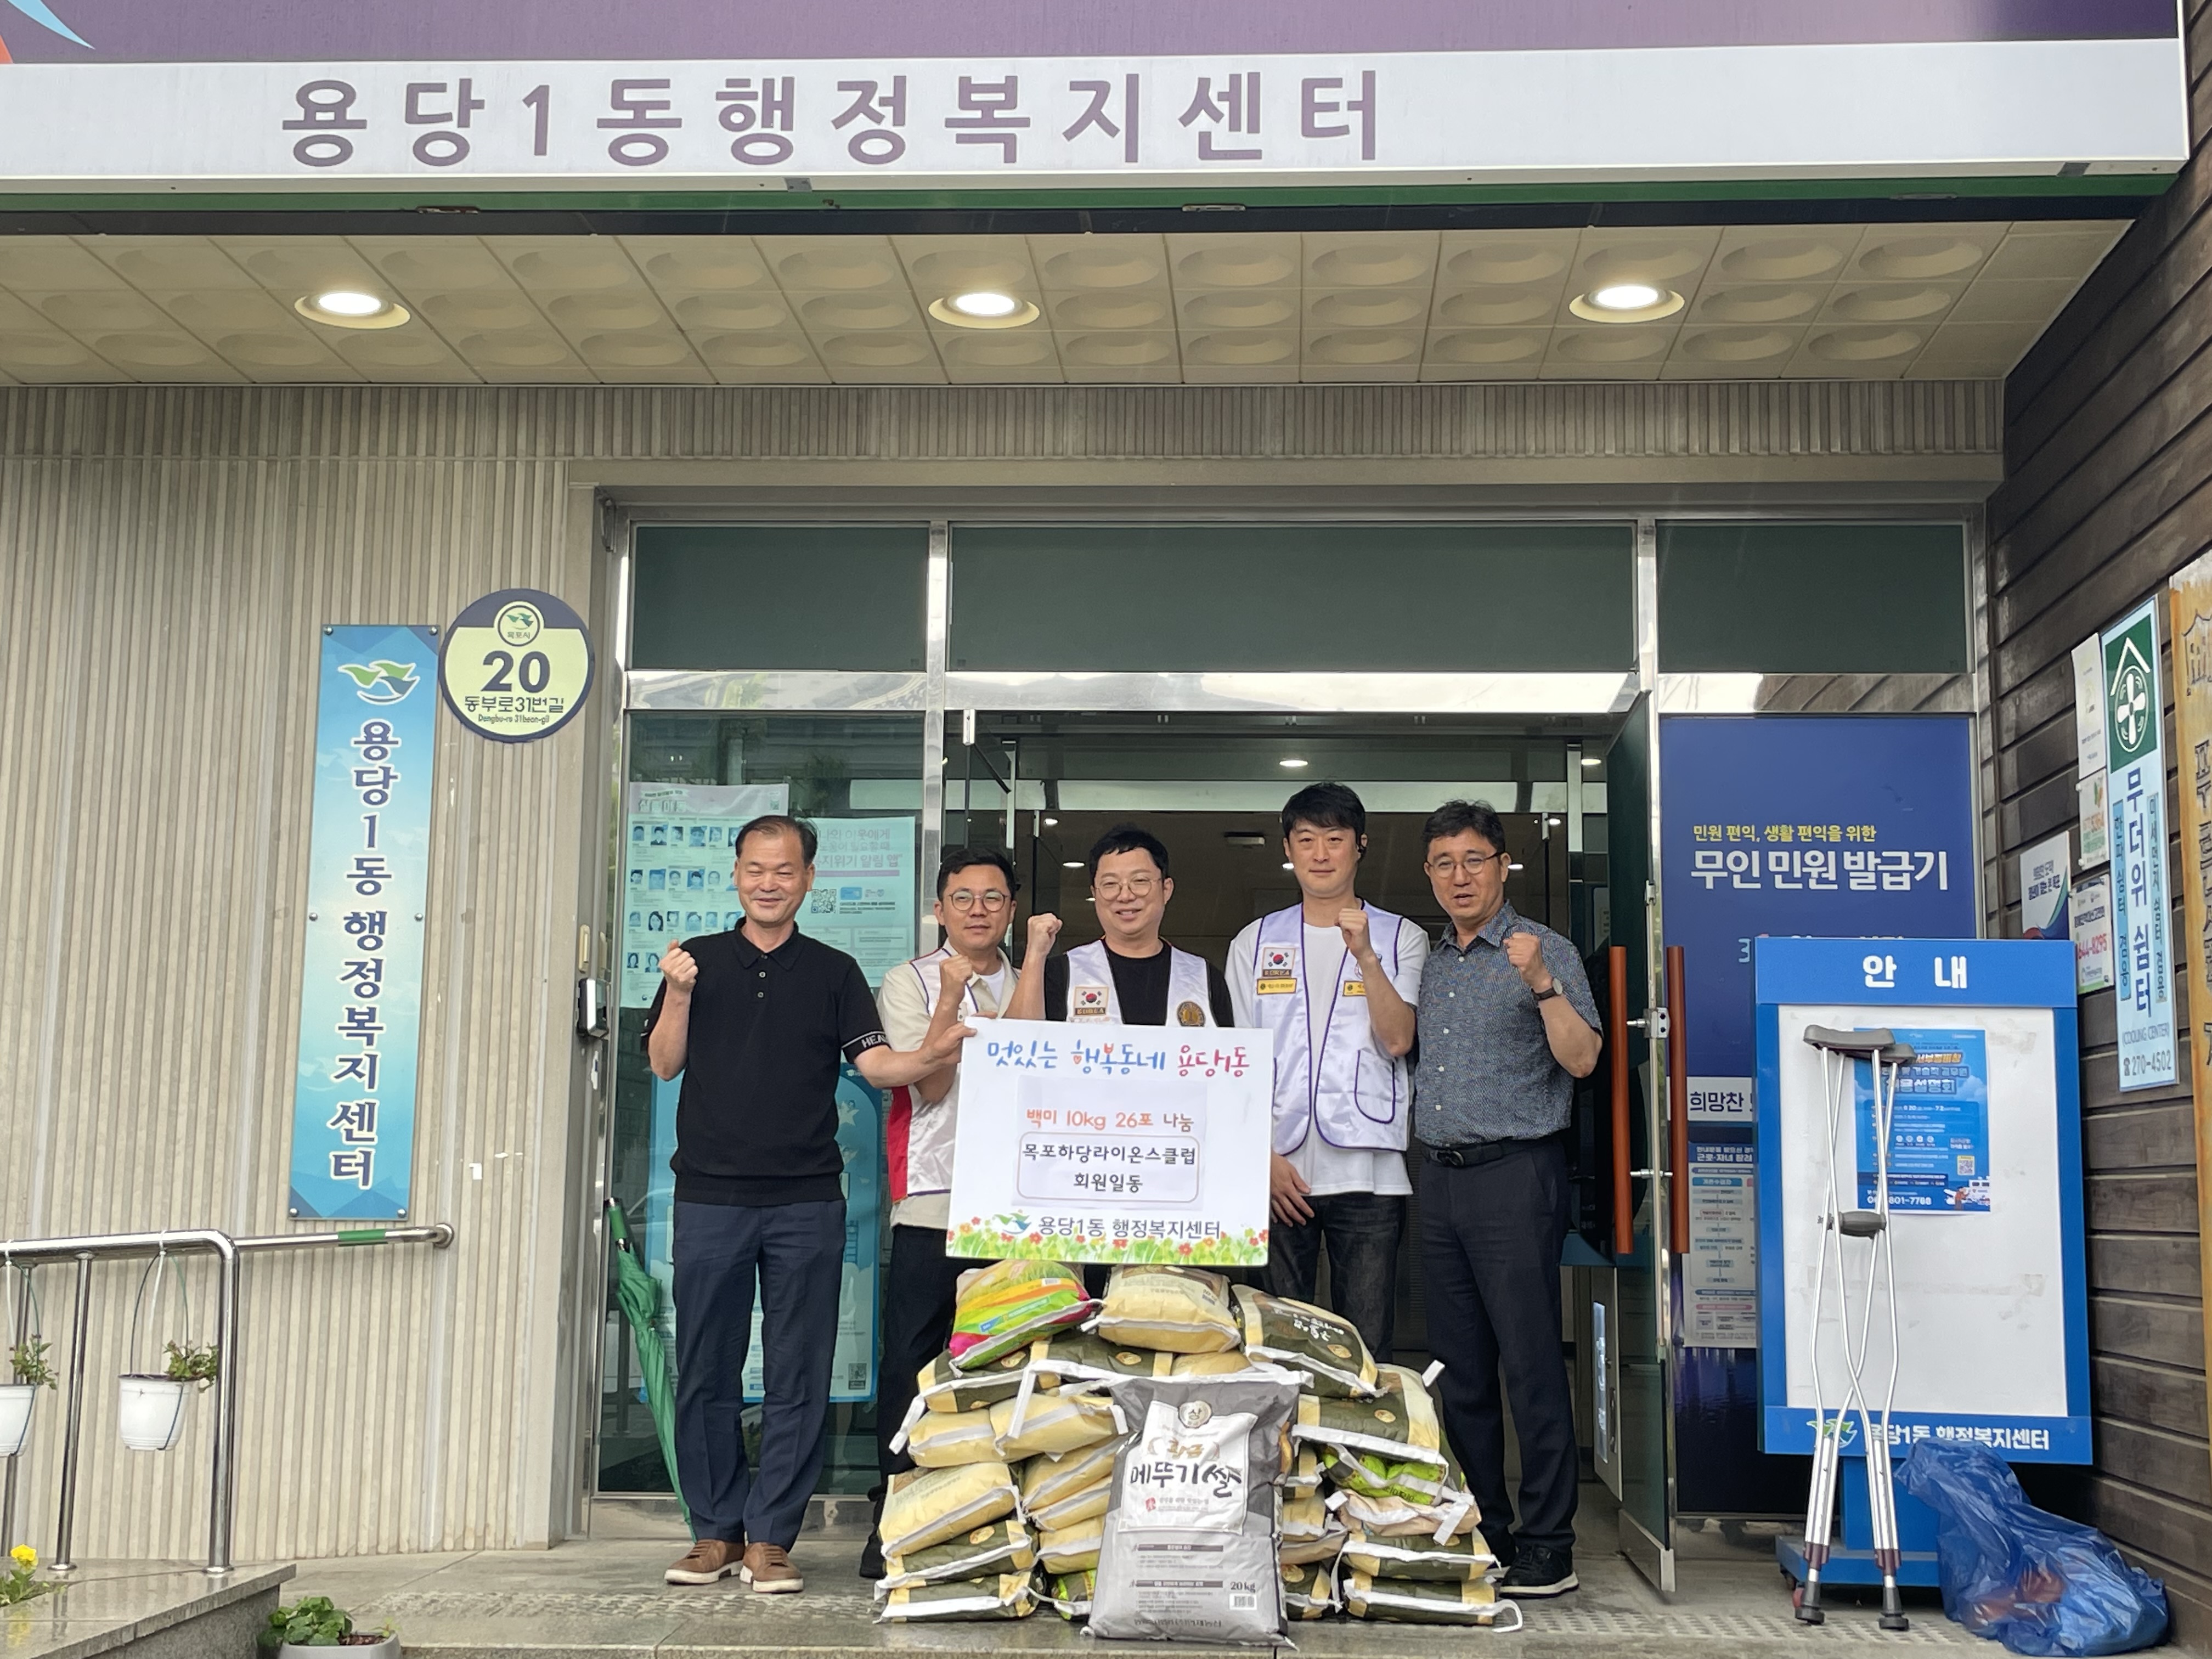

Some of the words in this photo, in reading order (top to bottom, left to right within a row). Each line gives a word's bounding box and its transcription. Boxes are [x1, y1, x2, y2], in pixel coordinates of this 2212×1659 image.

[281, 70, 1376, 167] 용당1동행정복지센터
[481, 650, 550, 693] 20
[465, 696, 564, 713] 동부로31번길
[845, 828, 890, 840] 이웃에게
[1694, 825, 1723, 842] 민원
[1726, 825, 1760, 843] 편익,
[1764, 826, 1794, 842] 생활
[1798, 826, 1842, 842] 편익을
[1846, 826, 1876, 842] 위한
[2126, 767, 2147, 907] 무더위
[1691, 850, 1761, 890] 무인
[1768, 850, 1838, 890] 민원
[1843, 851, 1949, 891] 발급기
[2133, 923, 2152, 1018] 쉼터
[988, 1040, 1058, 1069] 멋있는
[1070, 1039, 1166, 1075] 행복동네
[2132, 1049, 2171, 1075] 270-4502
[1690, 1091, 1744, 1113] 희망찬
[1026, 1107, 1057, 1128] 백미
[1066, 1110, 1106, 1131] 10kg
[1115, 1111, 1154, 1128] 26포
[1163, 1112, 1195, 1133] 나눔
[1023, 1143, 1197, 1166] 목포하당라이온스클럽
[1073, 1172, 1143, 1194] 회원일동
[1038, 1216, 1105, 1238] 용당1동
[1112, 1217, 1221, 1240] 행정복지센터
[1130, 1461, 1243, 1499] 메뚜기쌀
